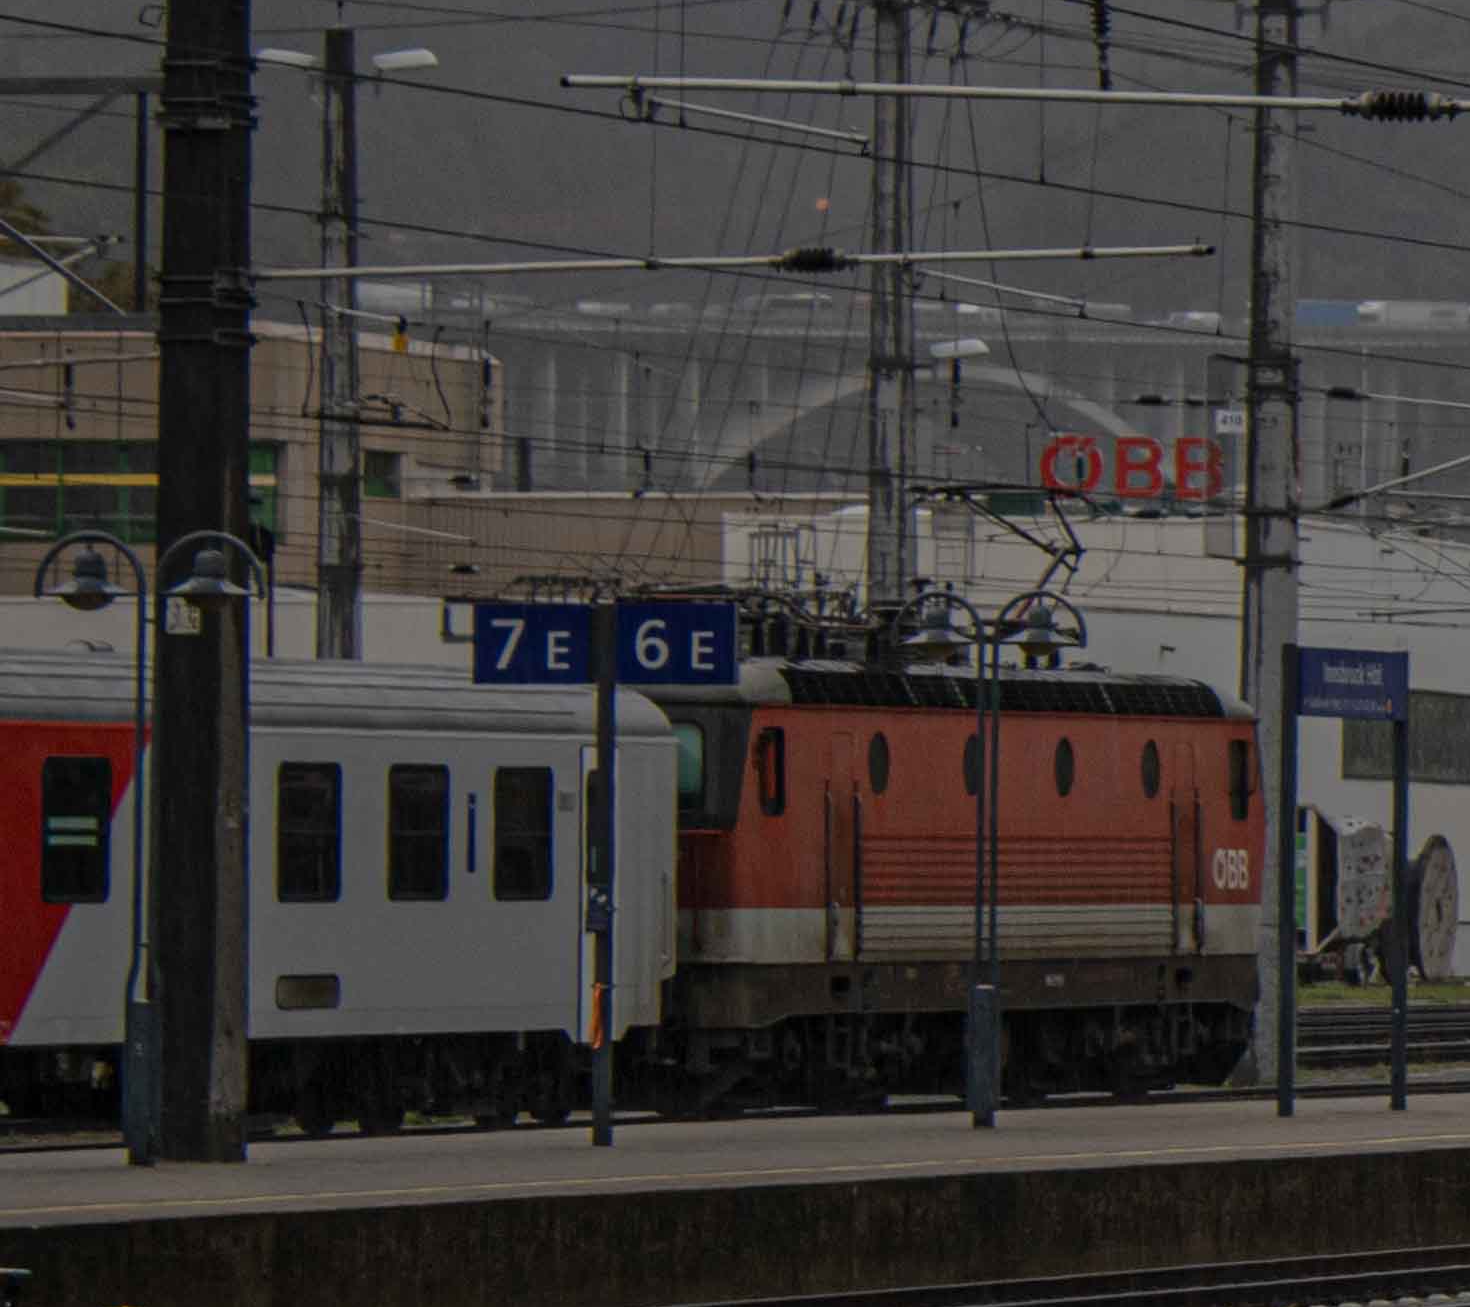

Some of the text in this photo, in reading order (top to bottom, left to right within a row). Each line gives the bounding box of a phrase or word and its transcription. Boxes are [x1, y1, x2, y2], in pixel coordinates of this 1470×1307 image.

[490, 618, 572, 671] 7 E
[633, 617, 716, 671] 6 E
